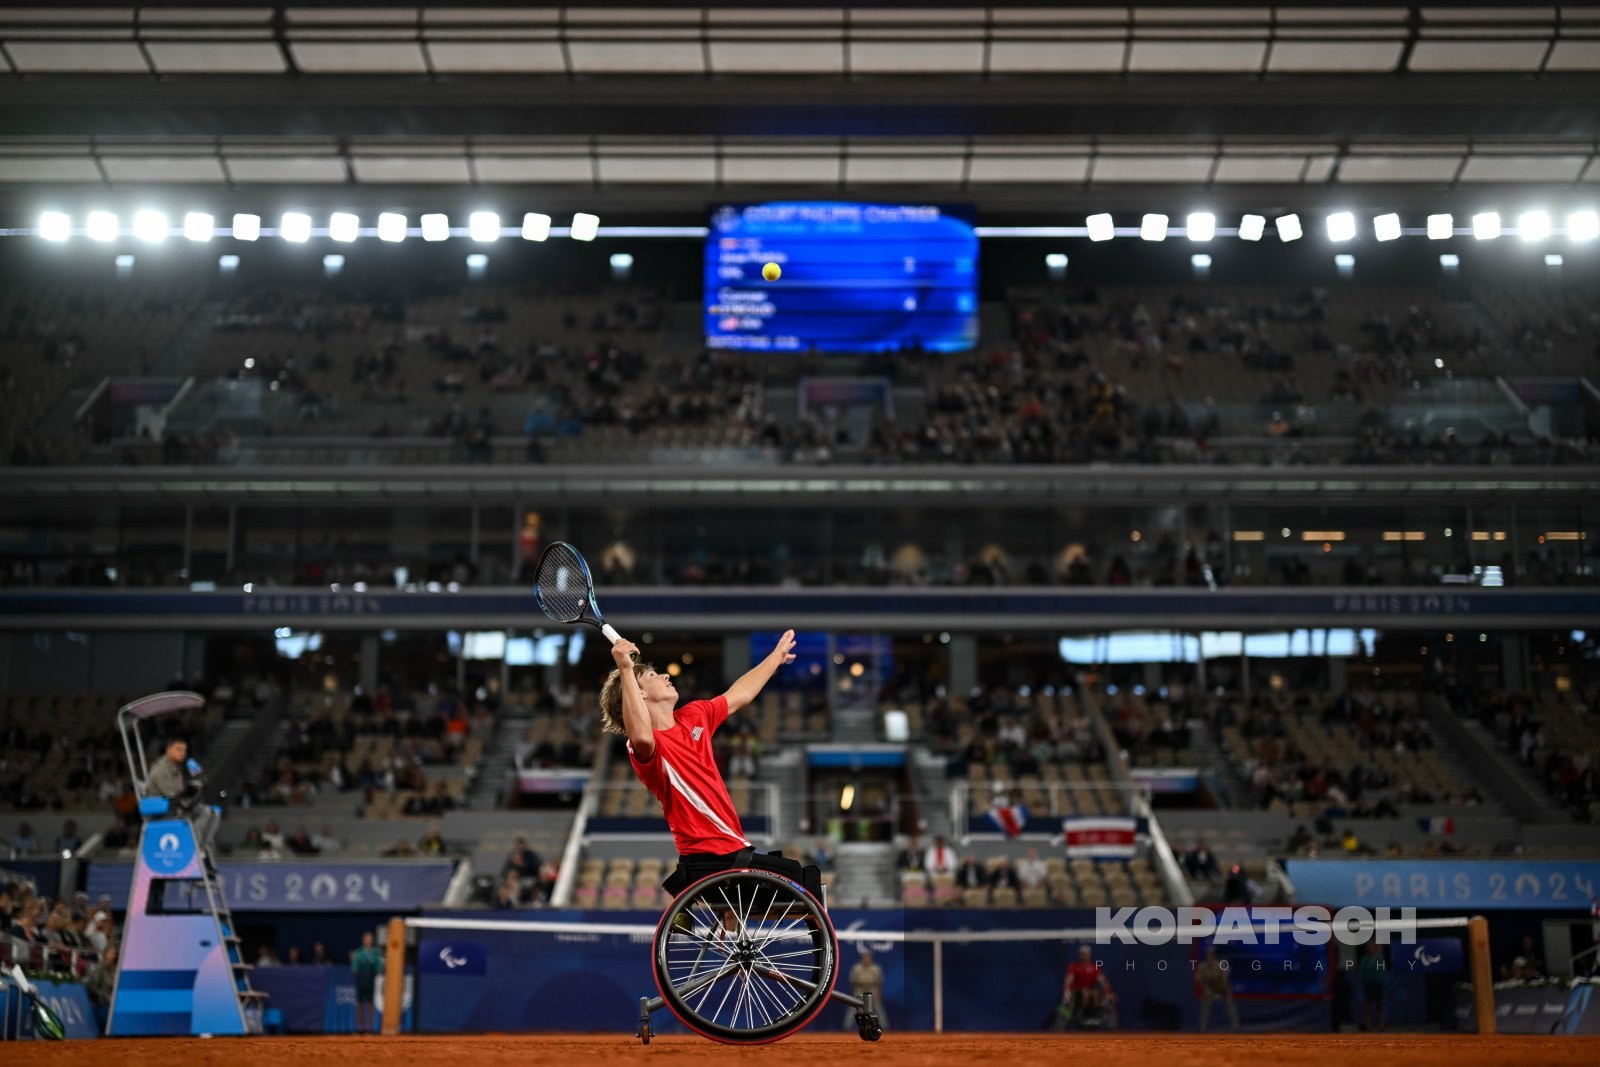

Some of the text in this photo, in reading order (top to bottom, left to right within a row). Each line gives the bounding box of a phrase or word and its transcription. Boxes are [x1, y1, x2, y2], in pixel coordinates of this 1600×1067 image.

[243, 596, 381, 613] PARIS 2024
[1334, 594, 1470, 612] PARIS 2024
[285, 873, 390, 902] 2024
[1355, 872, 1593, 900] PARIS 2024
